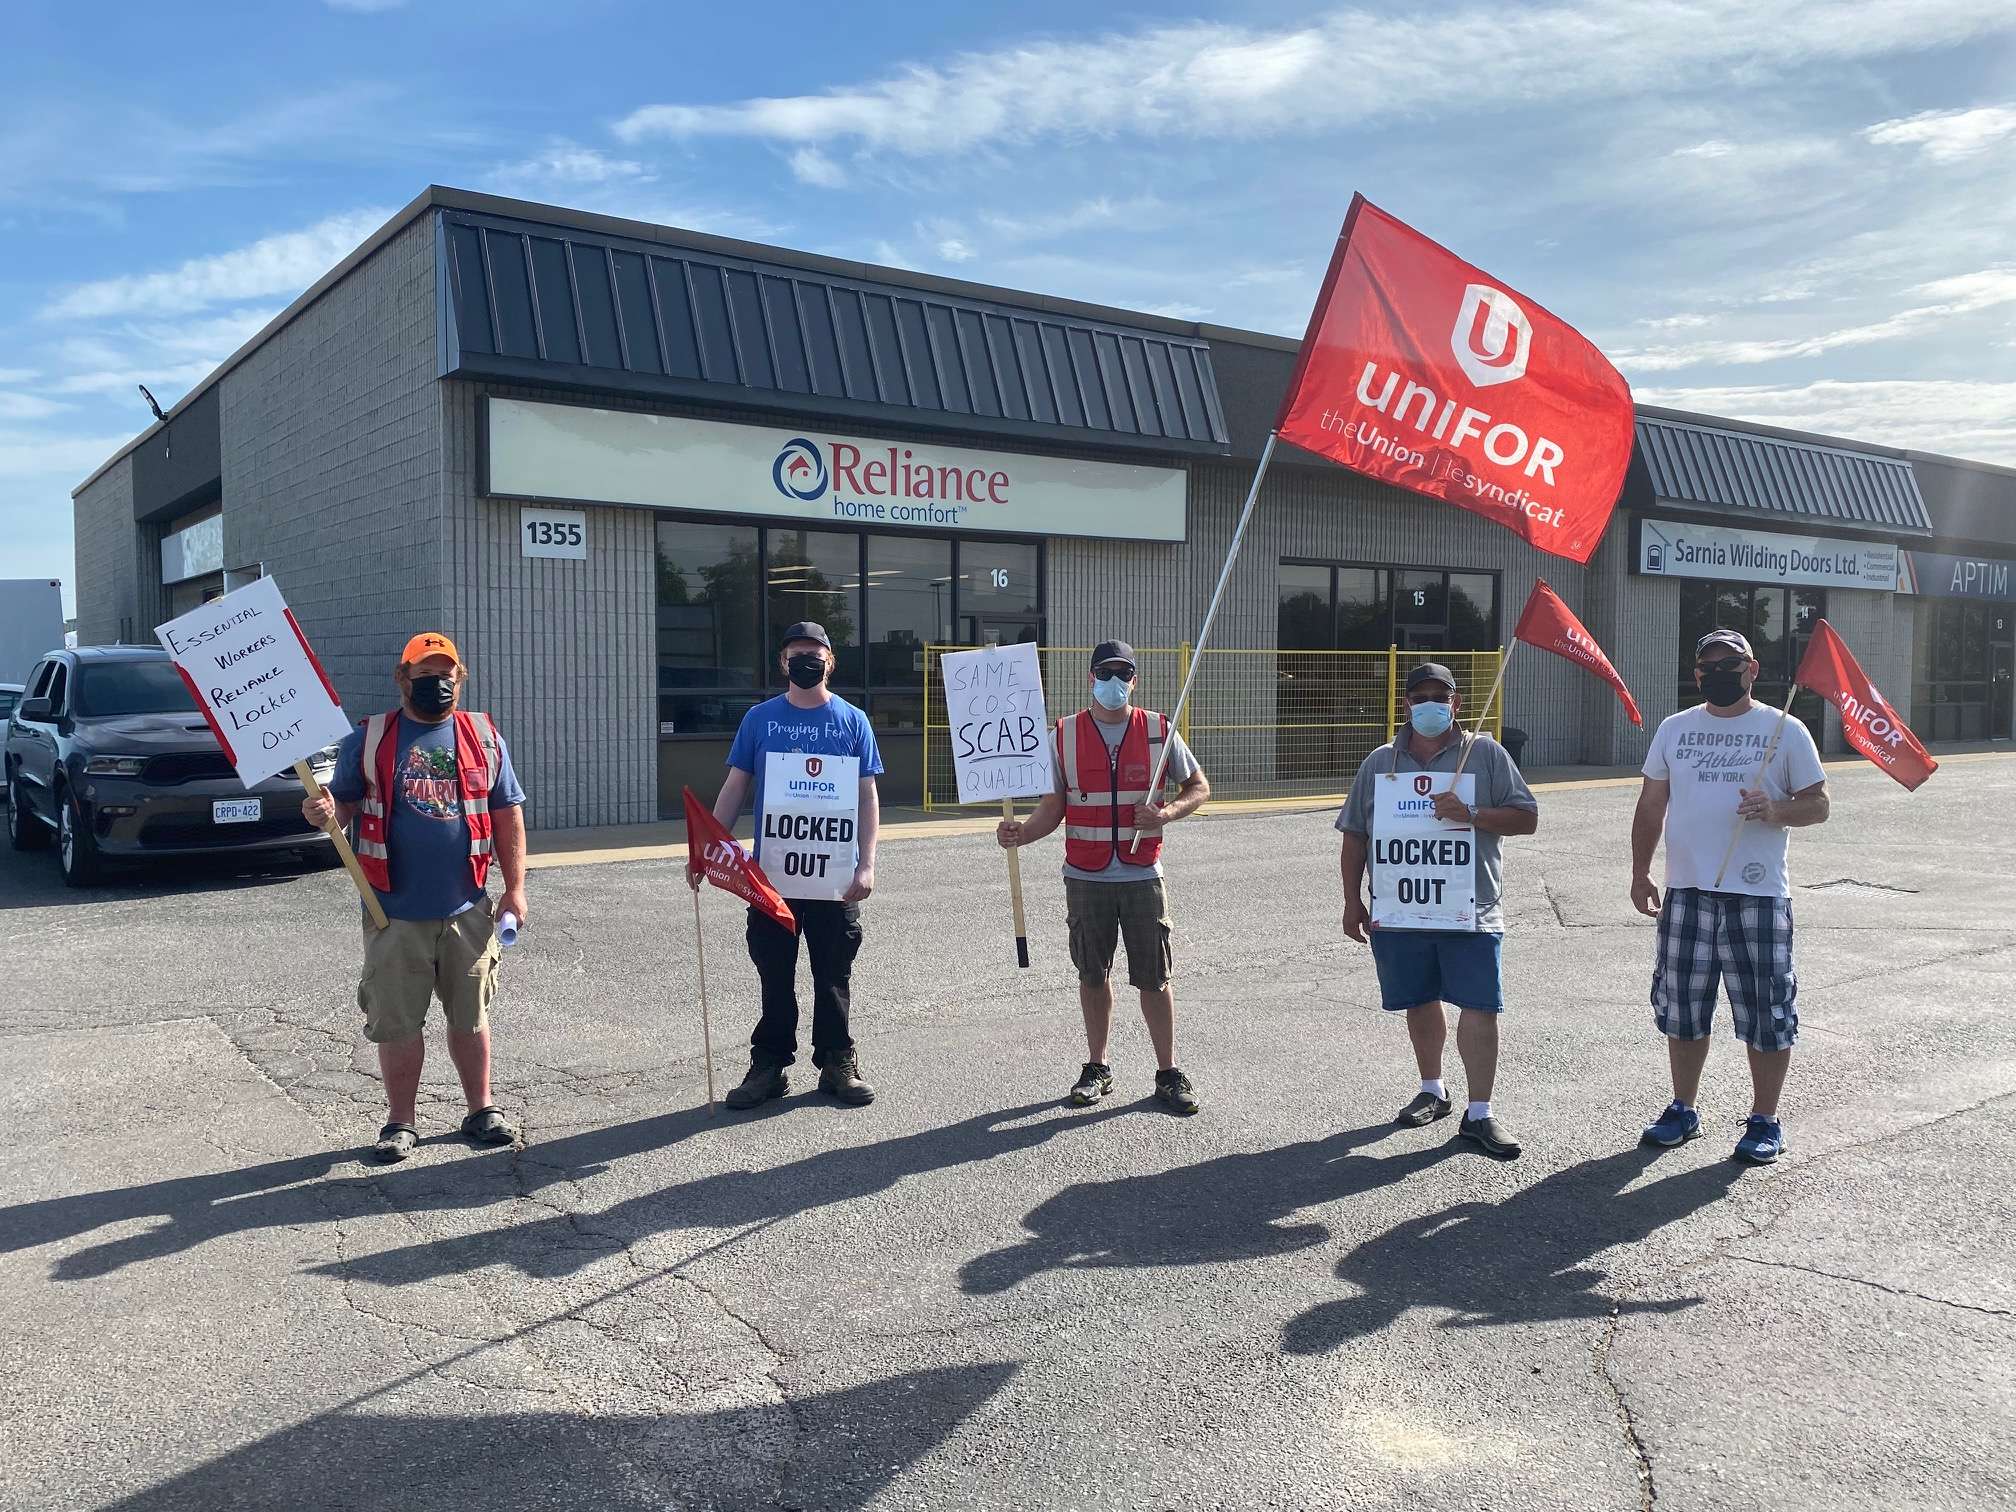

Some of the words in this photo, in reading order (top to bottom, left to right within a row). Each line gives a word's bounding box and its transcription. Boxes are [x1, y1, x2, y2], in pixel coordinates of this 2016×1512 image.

[827, 442, 1010, 504] Reliance
[834, 495, 885, 519] home
[526, 521, 582, 546] 1355
[1675, 538, 1726, 565] Sarnia
[1730, 543, 1787, 576] Wilding
[1791, 549, 1832, 574] Doors
[1835, 553, 1860, 576] Ltd.
[990, 568, 1009, 588] 16
[1950, 560, 2008, 596] APTIM
[1413, 590, 1425, 606] 15
[165, 607, 264, 656] ESSENTIAL
[214, 634, 277, 671] WORKERS
[210, 666, 285, 709] RELIANCE
[953, 660, 1023, 691] SAME
[968, 688, 1040, 717] COST
[262, 719, 304, 750] OUT
[768, 721, 819, 742] Praying
[824, 722, 842, 738] For
[958, 716, 1040, 759] SCAB
[406, 778, 459, 802] MARV
[966, 761, 1049, 792] QUALITY
[1698, 771, 1719, 783] NEW
[1721, 771, 1745, 783] YORK
[764, 813, 854, 843] LOCKED
[784, 851, 831, 878] OUT
[1375, 838, 1471, 866] LOCKED
[1398, 877, 1447, 905] OUT
